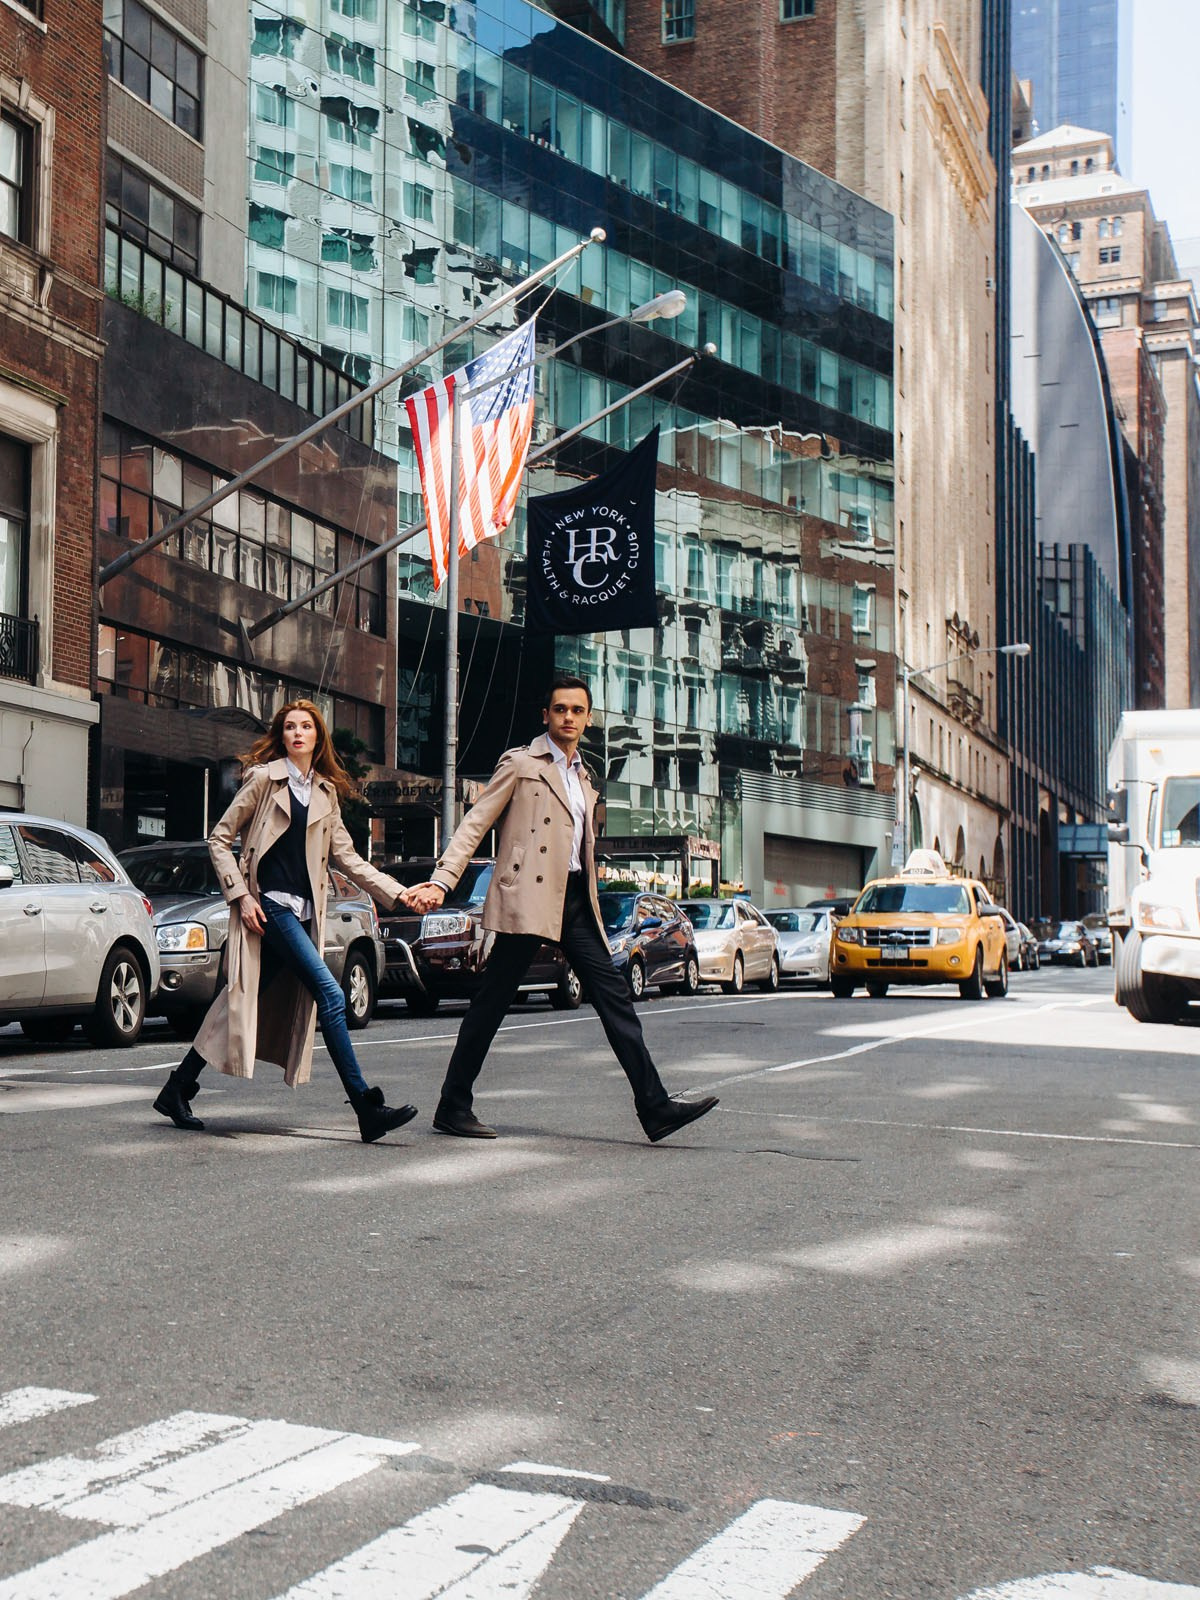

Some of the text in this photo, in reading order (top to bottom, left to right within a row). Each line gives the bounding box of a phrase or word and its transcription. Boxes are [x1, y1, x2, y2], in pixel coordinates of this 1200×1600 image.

[555, 506, 628, 530] NEW YORK
[542, 531, 640, 605] HEALTH & RACQUET CLUB
